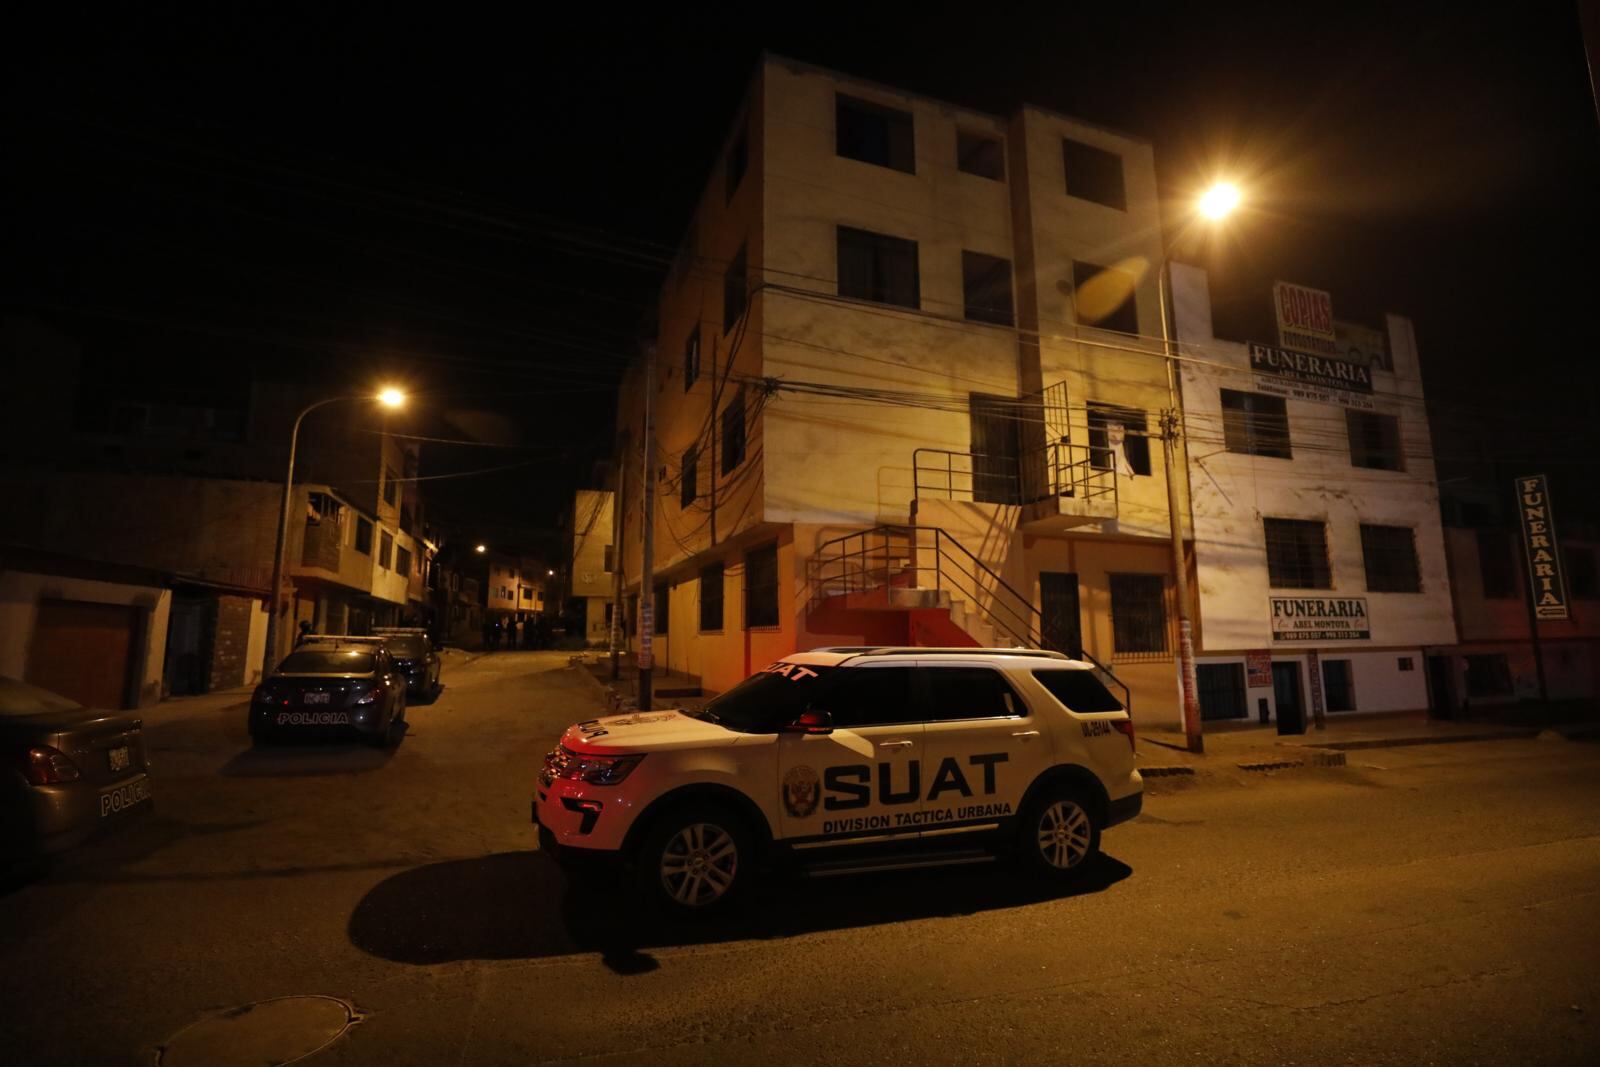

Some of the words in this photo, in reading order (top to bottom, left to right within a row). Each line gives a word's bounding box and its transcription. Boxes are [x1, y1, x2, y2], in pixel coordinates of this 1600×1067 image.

[1280, 285, 1330, 332] COPIAS
[1253, 344, 1369, 384] FUNERARIA
[1521, 478, 1560, 605] FUNERARIA
[1272, 599, 1365, 617] FUNERARIA
[1293, 620, 1313, 629] ABEL
[1314, 620, 1351, 629] MONTOYA
[767, 663, 819, 681] UAT
[277, 712, 349, 725] POLICIA
[823, 752, 1009, 811] SUAT
[823, 814, 890, 834] DIVISION
[894, 808, 954, 825] TACTICA
[957, 802, 1012, 820] URBANA
